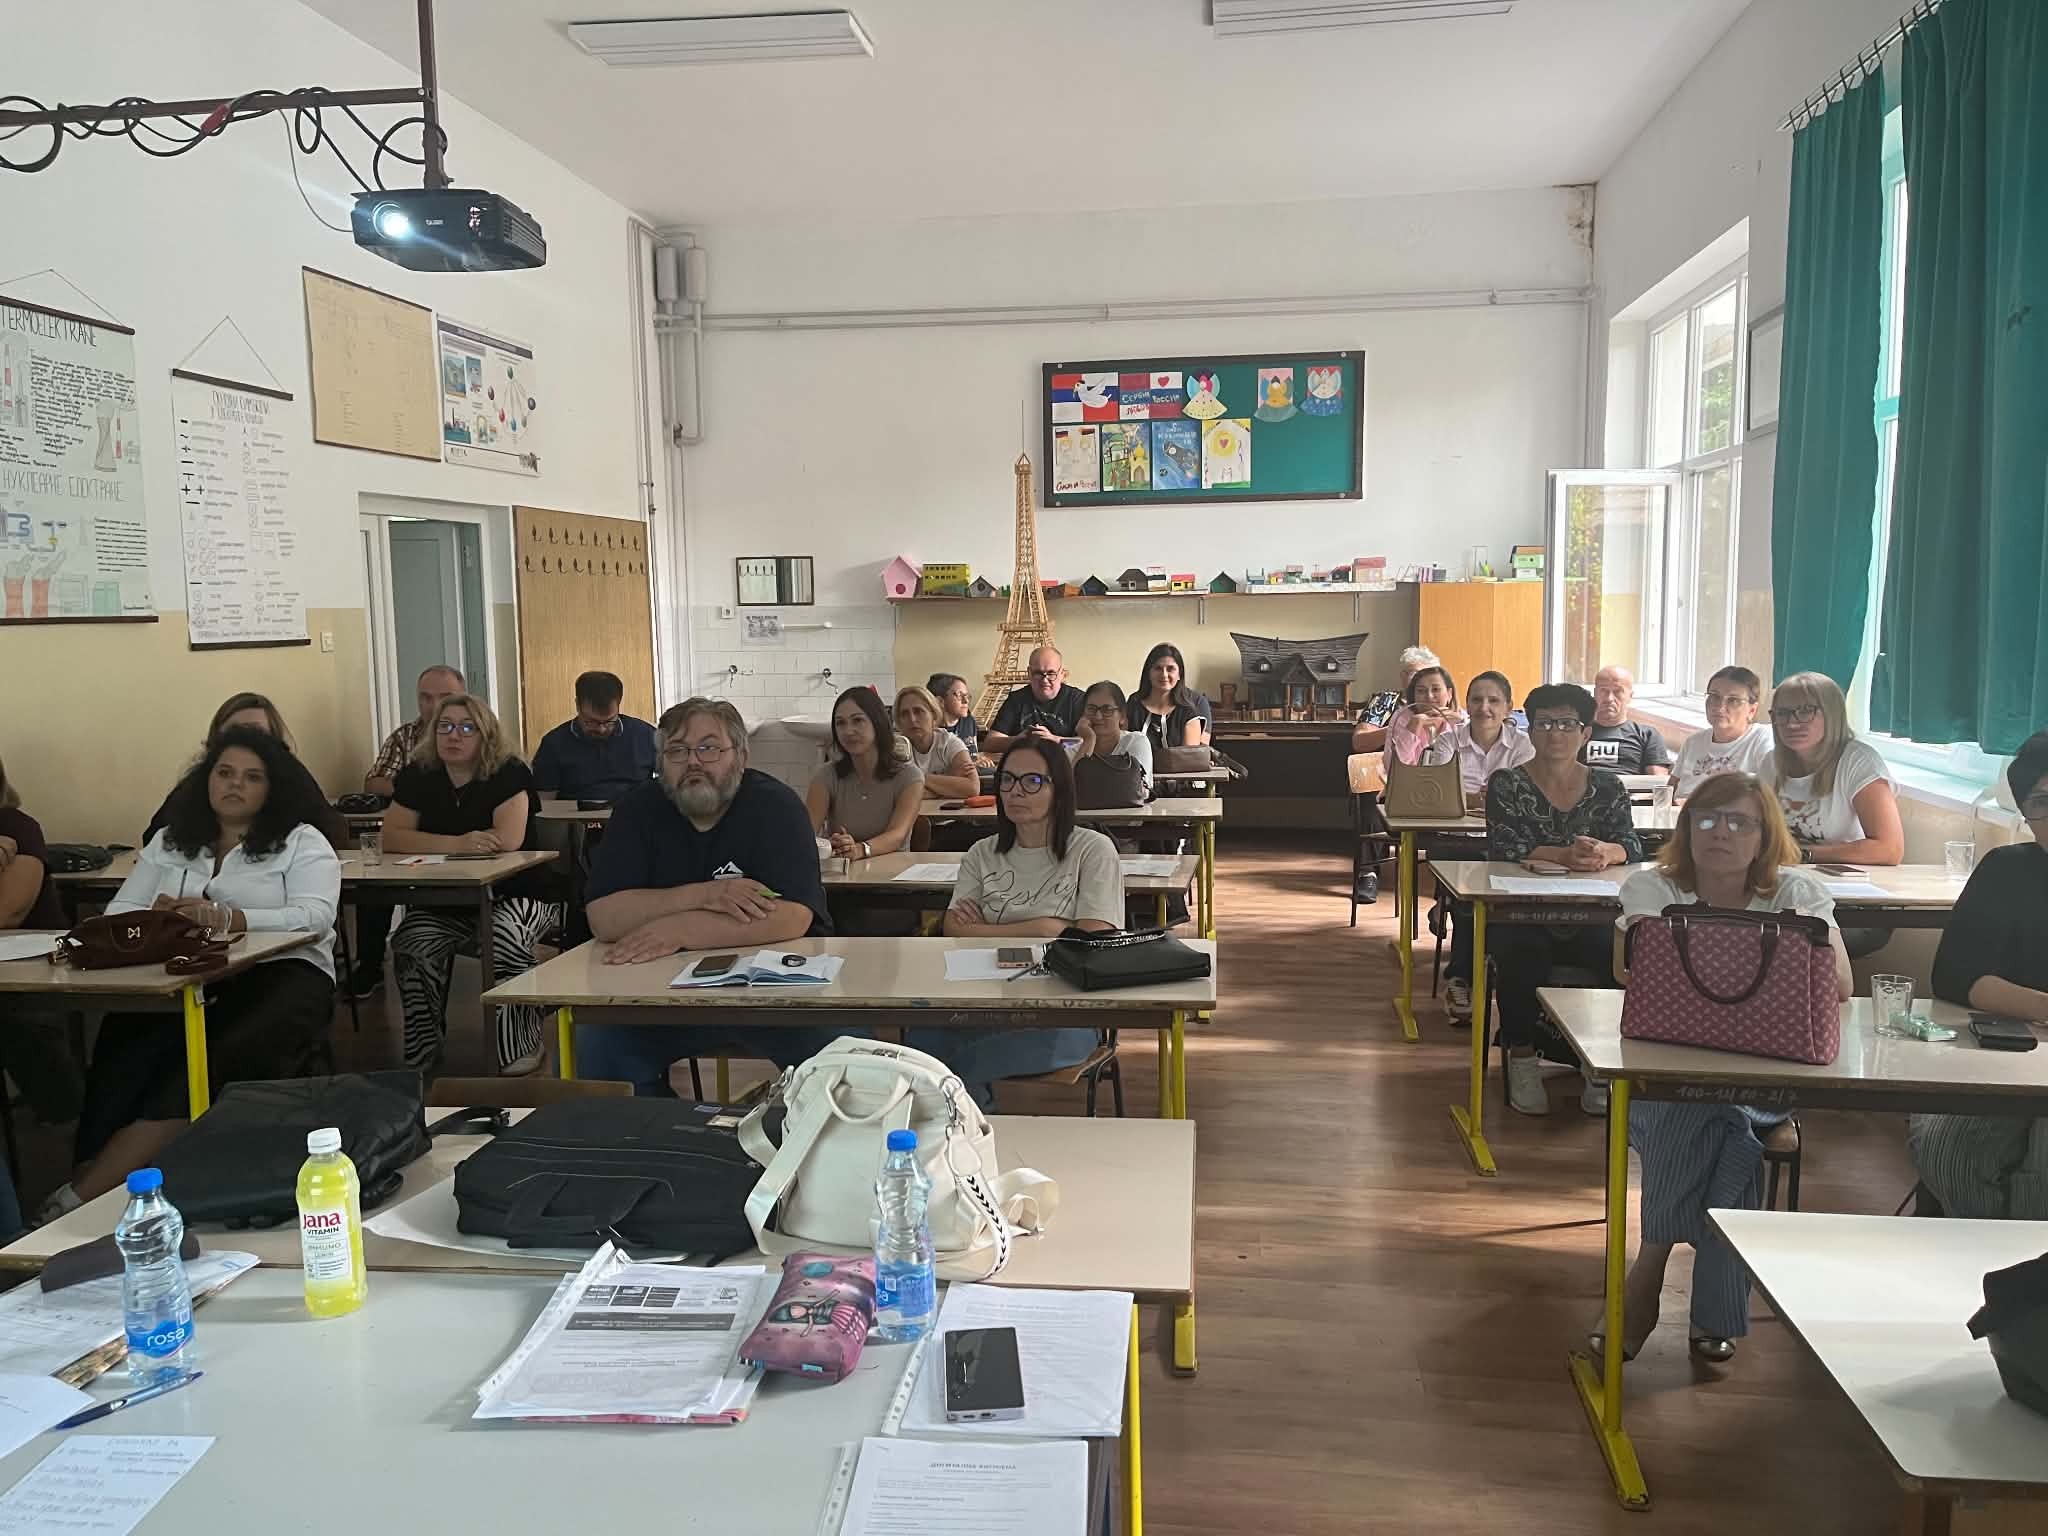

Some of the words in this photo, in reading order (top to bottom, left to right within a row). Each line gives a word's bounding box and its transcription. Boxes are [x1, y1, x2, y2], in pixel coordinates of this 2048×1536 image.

[1590, 745, 1616, 756] HU
[303, 1212, 342, 1230] Jana
[307, 1226, 340, 1236] VITAMIN
[147, 1328, 185, 1347] rosa
